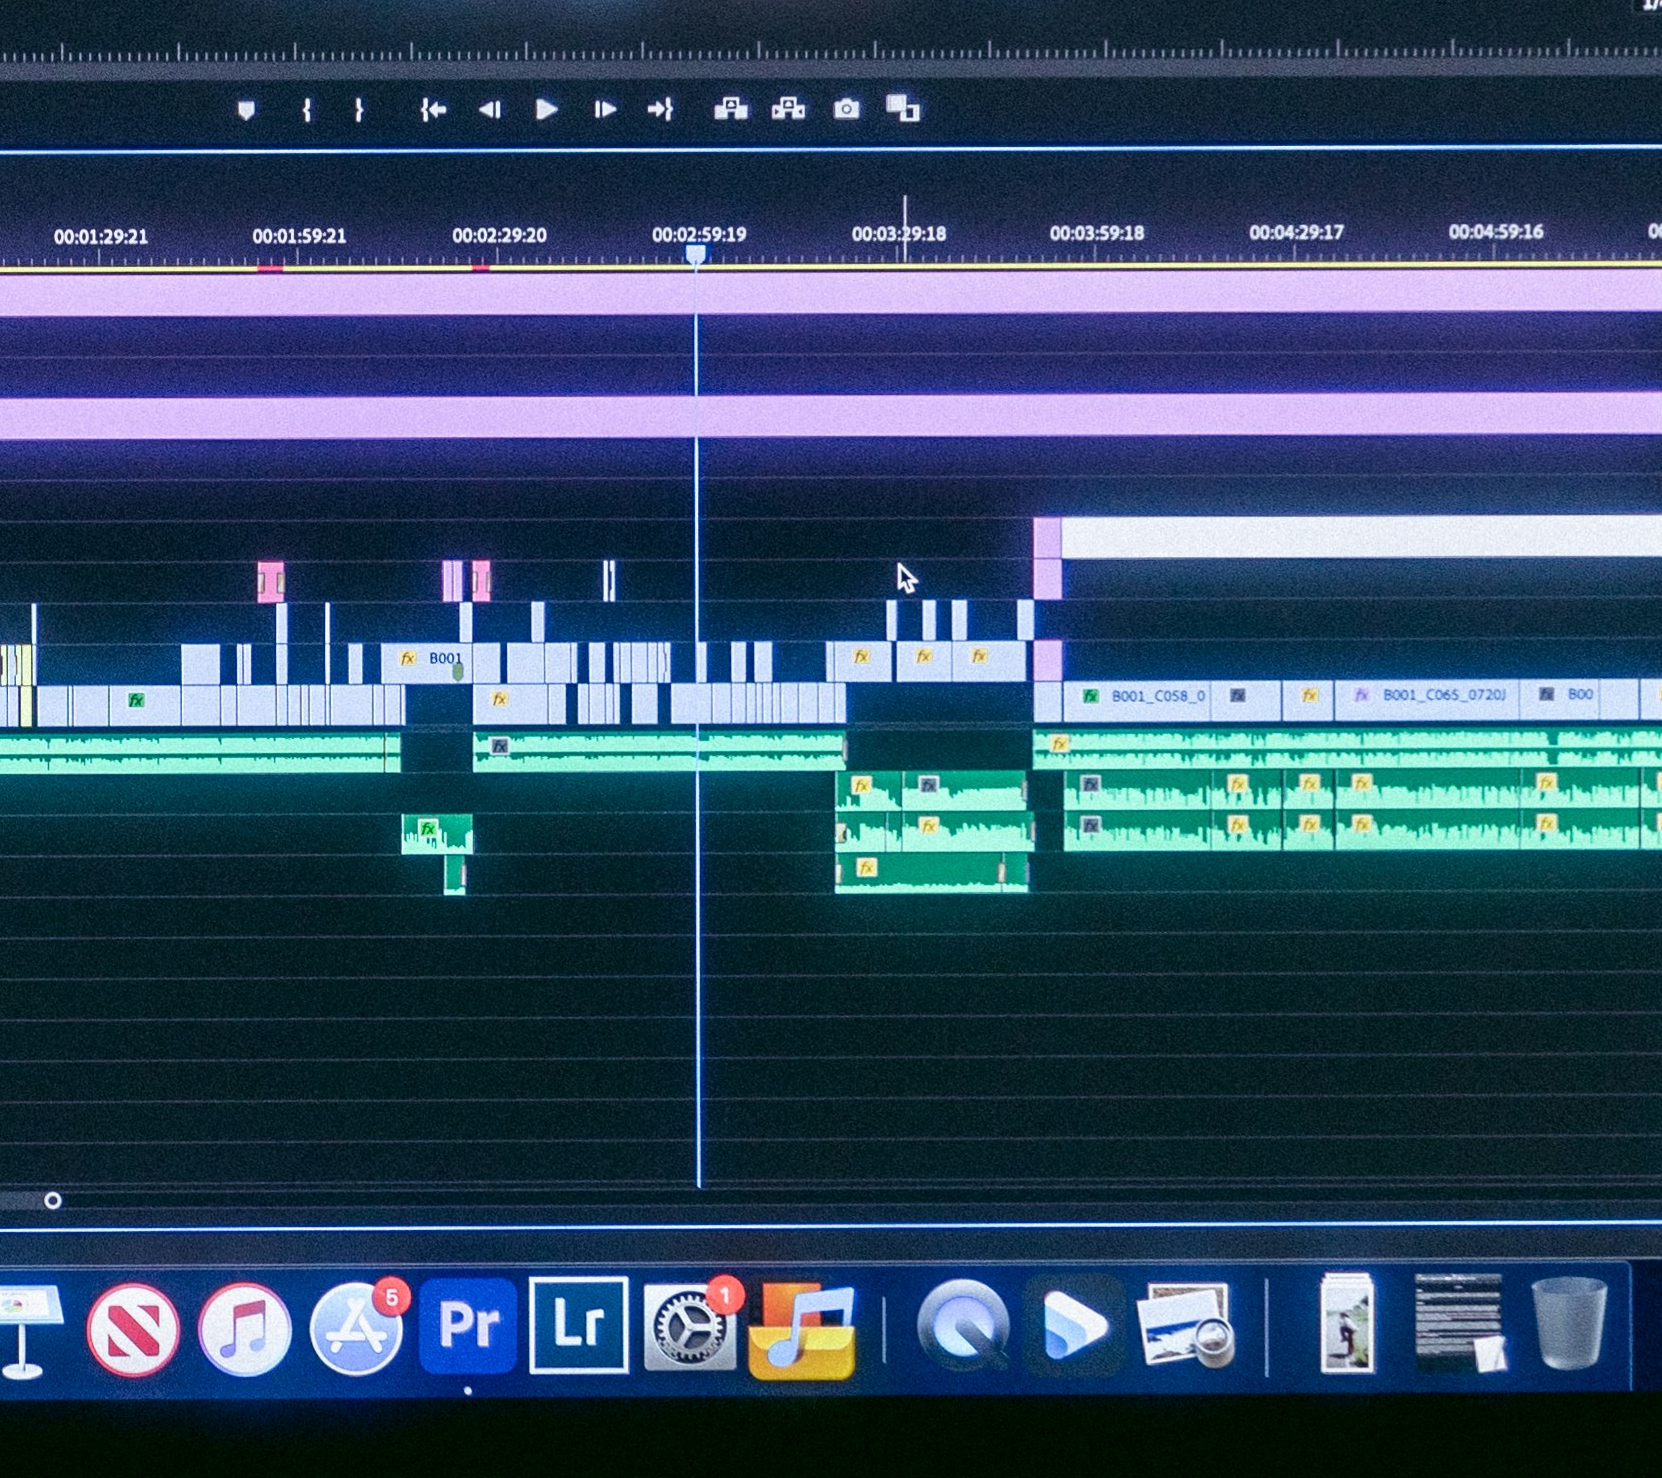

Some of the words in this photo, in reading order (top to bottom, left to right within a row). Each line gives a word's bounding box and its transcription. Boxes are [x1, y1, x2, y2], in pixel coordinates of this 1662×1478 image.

[452, 227, 548, 244] 00:02:29:20
[651, 226, 747, 250] 00:02:59:19
[1448, 223, 1545, 240] 00:04:59:16
[386, 1288, 399, 1307] 5
[720, 1286, 730, 1304] 1
[440, 1300, 501, 1348] Pr
[554, 1297, 605, 1346] Lr
